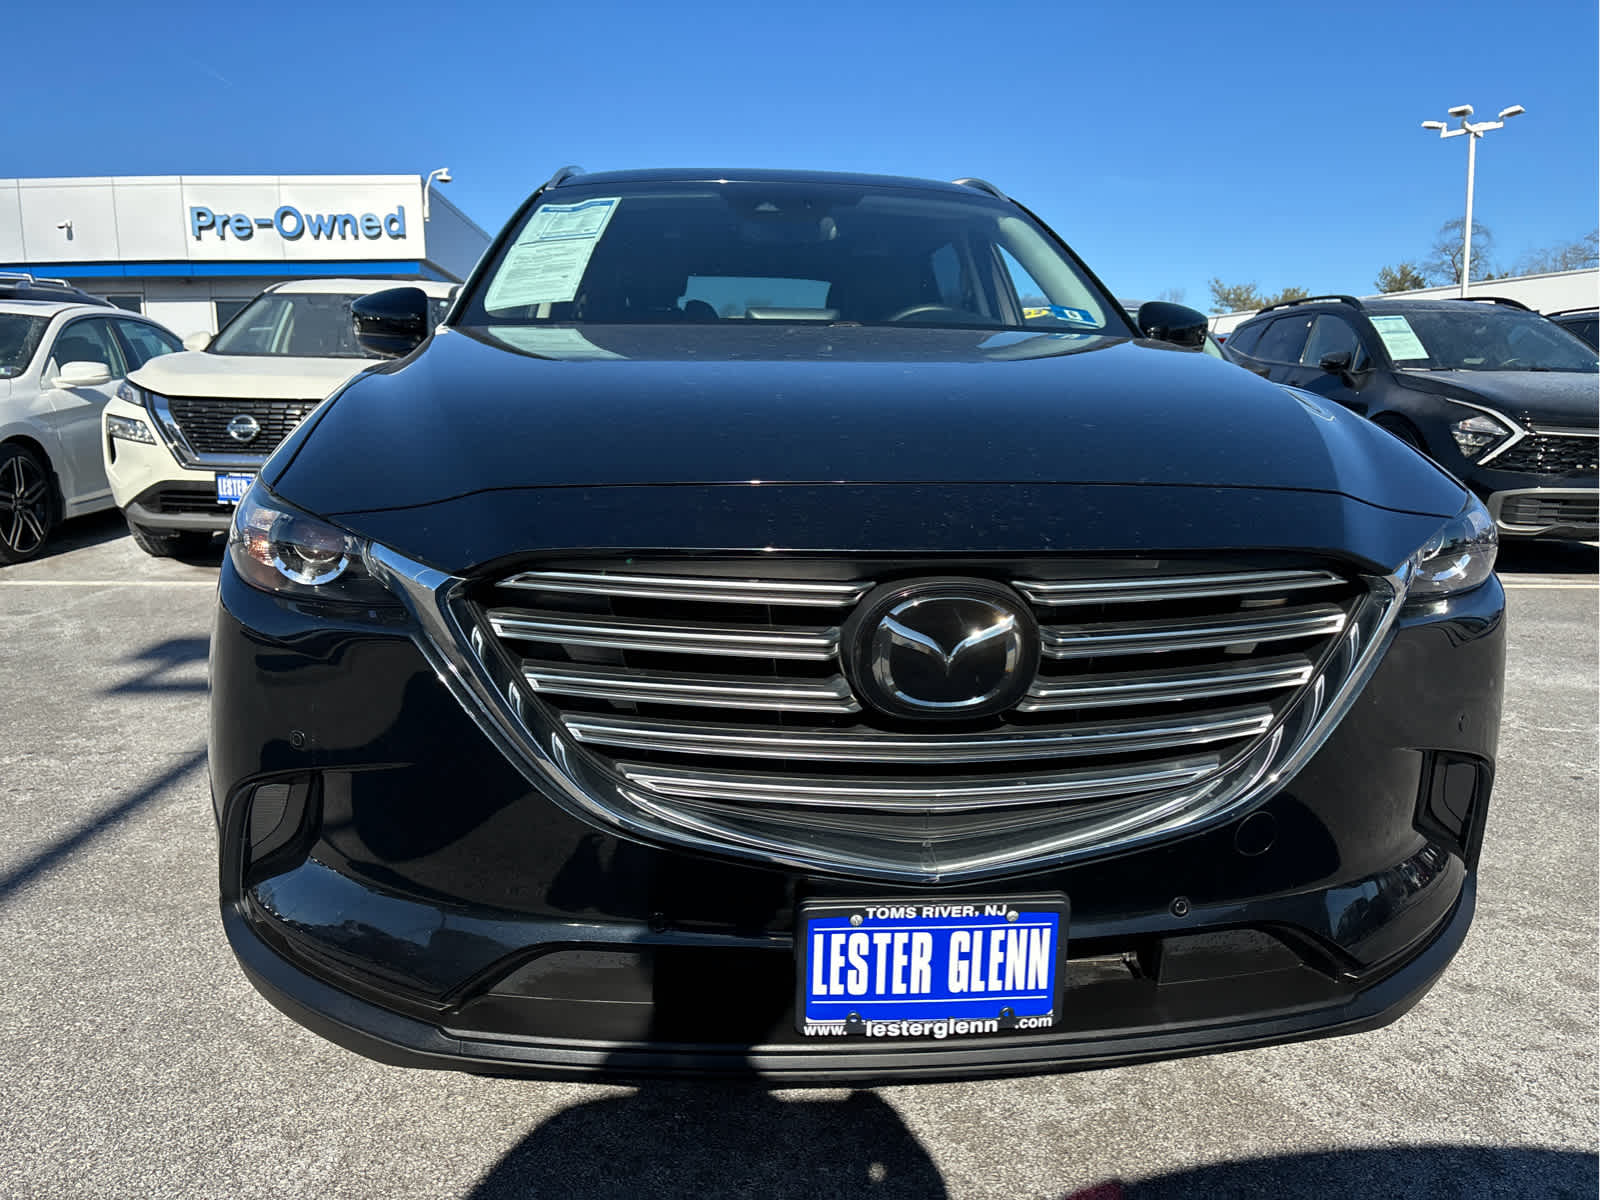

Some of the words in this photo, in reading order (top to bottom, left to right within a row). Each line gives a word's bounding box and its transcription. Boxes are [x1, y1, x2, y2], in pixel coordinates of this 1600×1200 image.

[189, 205, 407, 241] Pre-Owned
[866, 905, 918, 920] TOMS
[921, 904, 981, 919] RIVER,
[984, 904, 1008, 917] NJ
[811, 931, 934, 996] LESTER
[948, 927, 1052, 994] GLENN
[803, 1023, 848, 1037] www.
[865, 1018, 999, 1040] lesterglenn
[1014, 1014, 1053, 1030] .com
